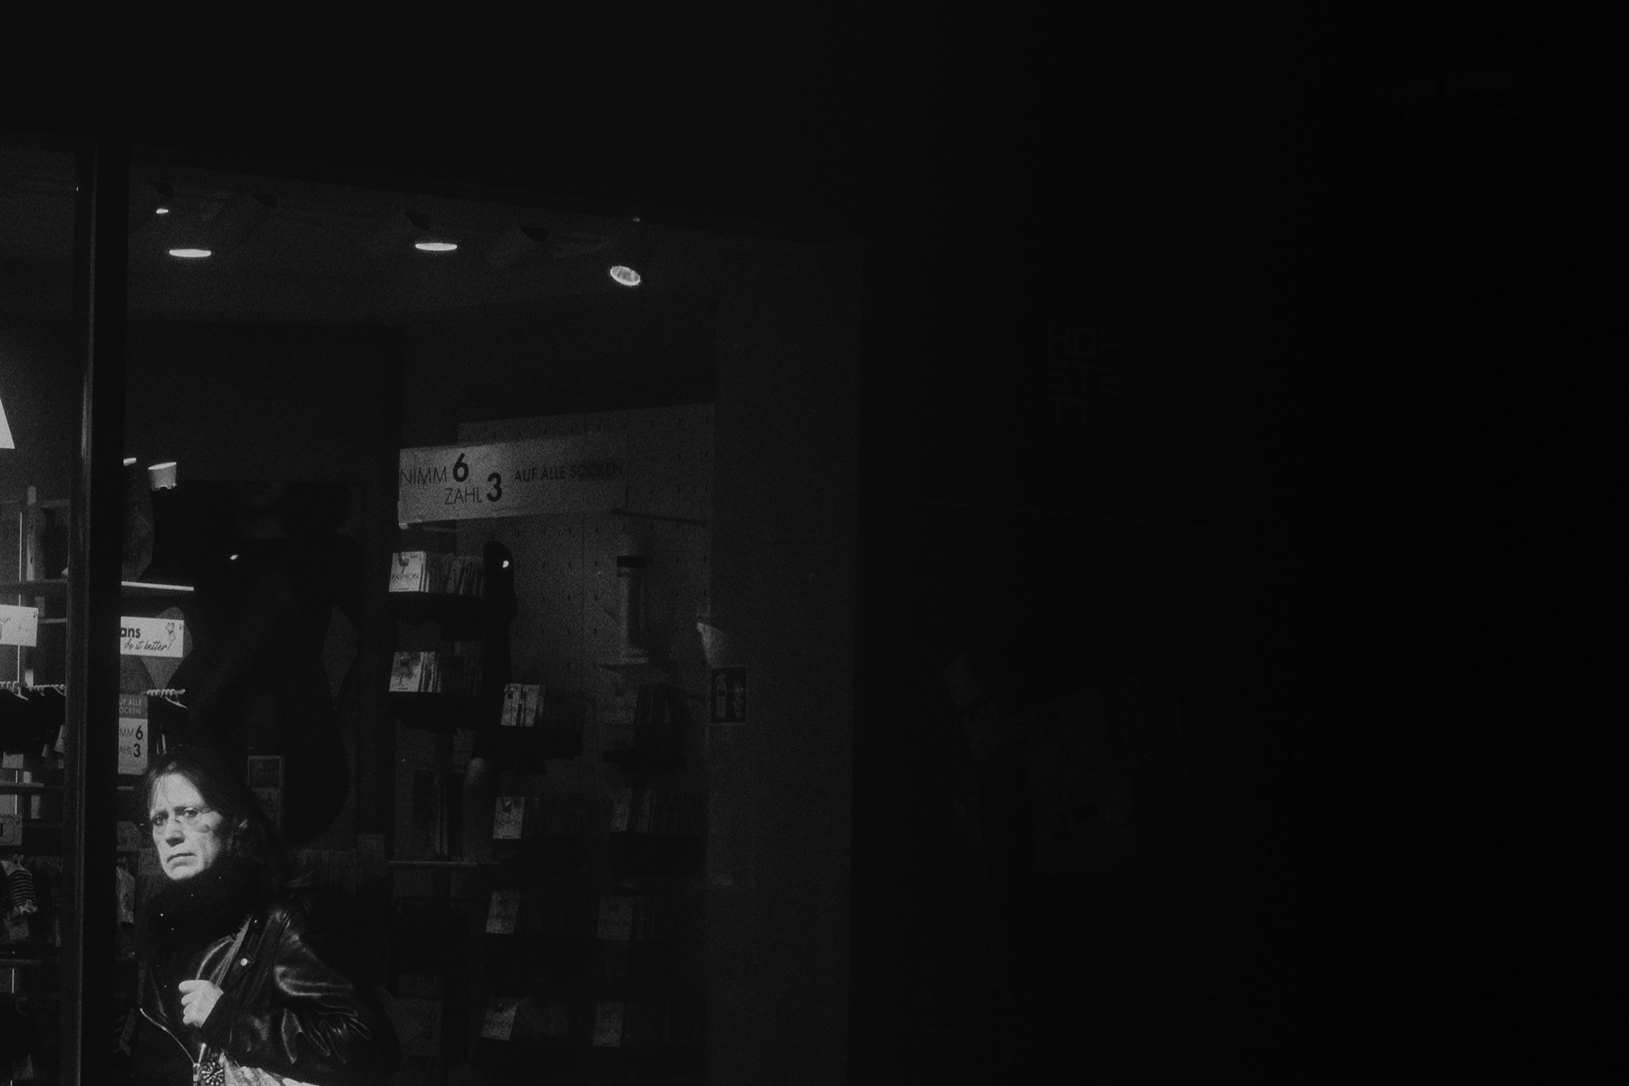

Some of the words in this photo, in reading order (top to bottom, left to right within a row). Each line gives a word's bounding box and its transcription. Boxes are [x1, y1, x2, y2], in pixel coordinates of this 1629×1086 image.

[400, 466, 448, 486] NIMM
[452, 452, 469, 482] 6
[514, 467, 538, 482] AUF
[540, 463, 567, 480] ALLE
[568, 460, 624, 479] SOCKEN
[444, 486, 483, 506] ZAHL
[486, 472, 502, 503] 3
[119, 626, 142, 639] ans
[123, 637, 135, 651] do
[135, 639, 145, 651] it
[119, 705, 142, 715] OCKEN
[127, 698, 143, 707] ALLE
[135, 724, 144, 741] 6
[119, 743, 132, 756] AHL
[132, 742, 142, 759] 3
